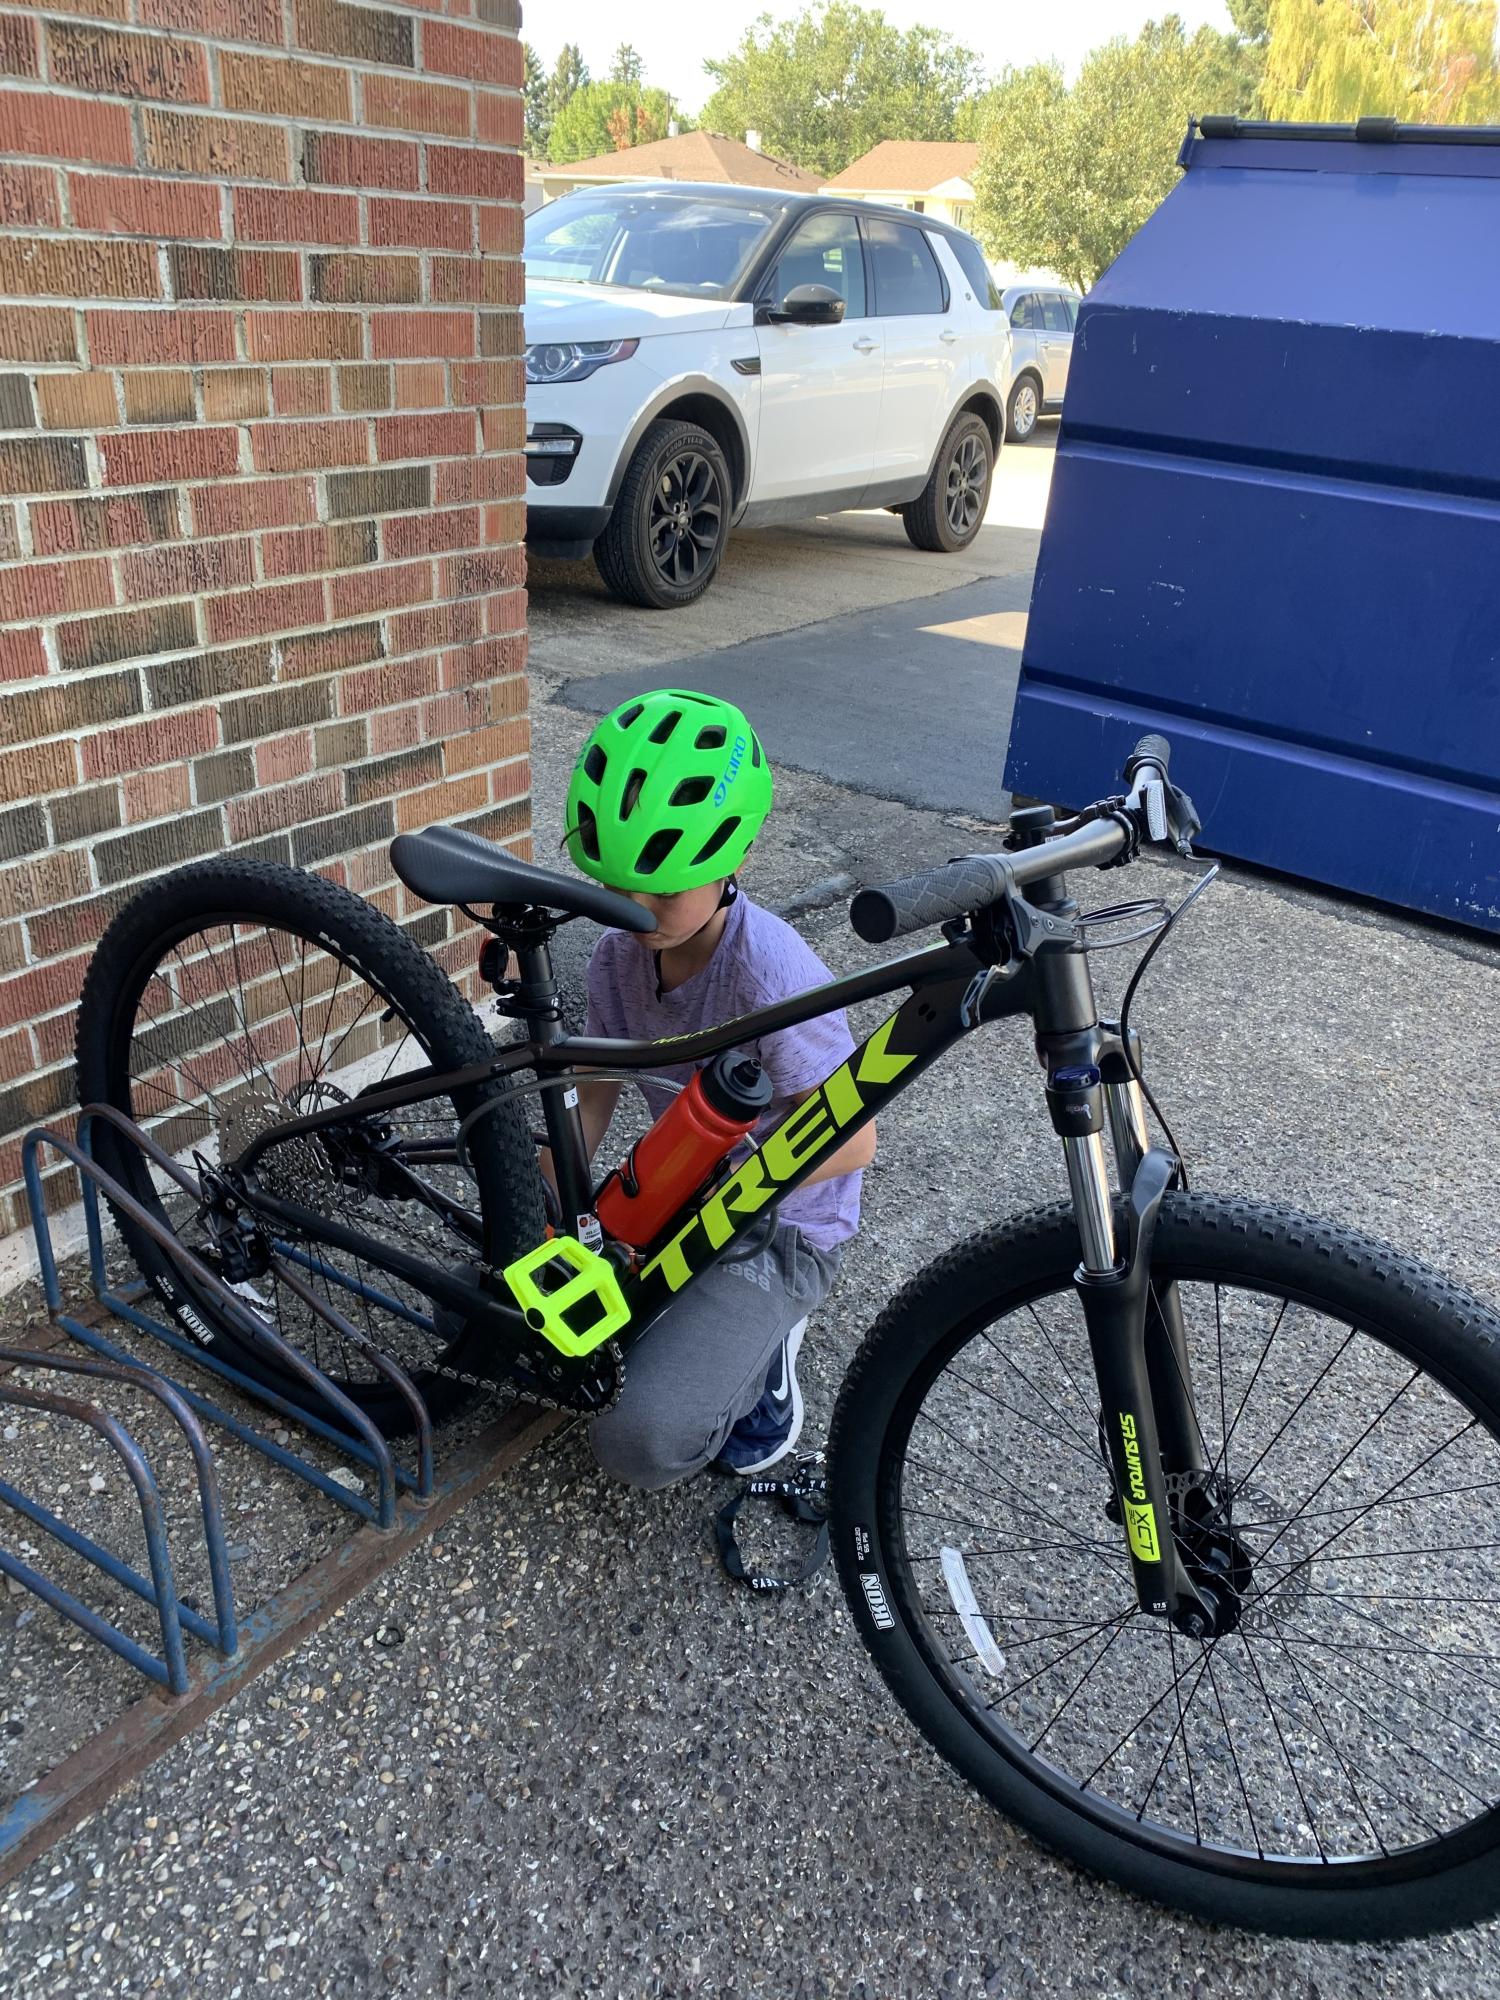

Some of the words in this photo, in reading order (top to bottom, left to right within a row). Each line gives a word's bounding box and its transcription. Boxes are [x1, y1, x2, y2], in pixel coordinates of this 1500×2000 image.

[723, 735, 747, 784] GIRO
[640, 1010, 917, 1293] TREK
[177, 1304, 215, 1346] IKON
[750, 1482, 776, 1493] KEYS
[1123, 1438, 1145, 1500] SUNTOUR
[1135, 1510, 1154, 1556] XCT
[859, 1573, 895, 1630] IKON
